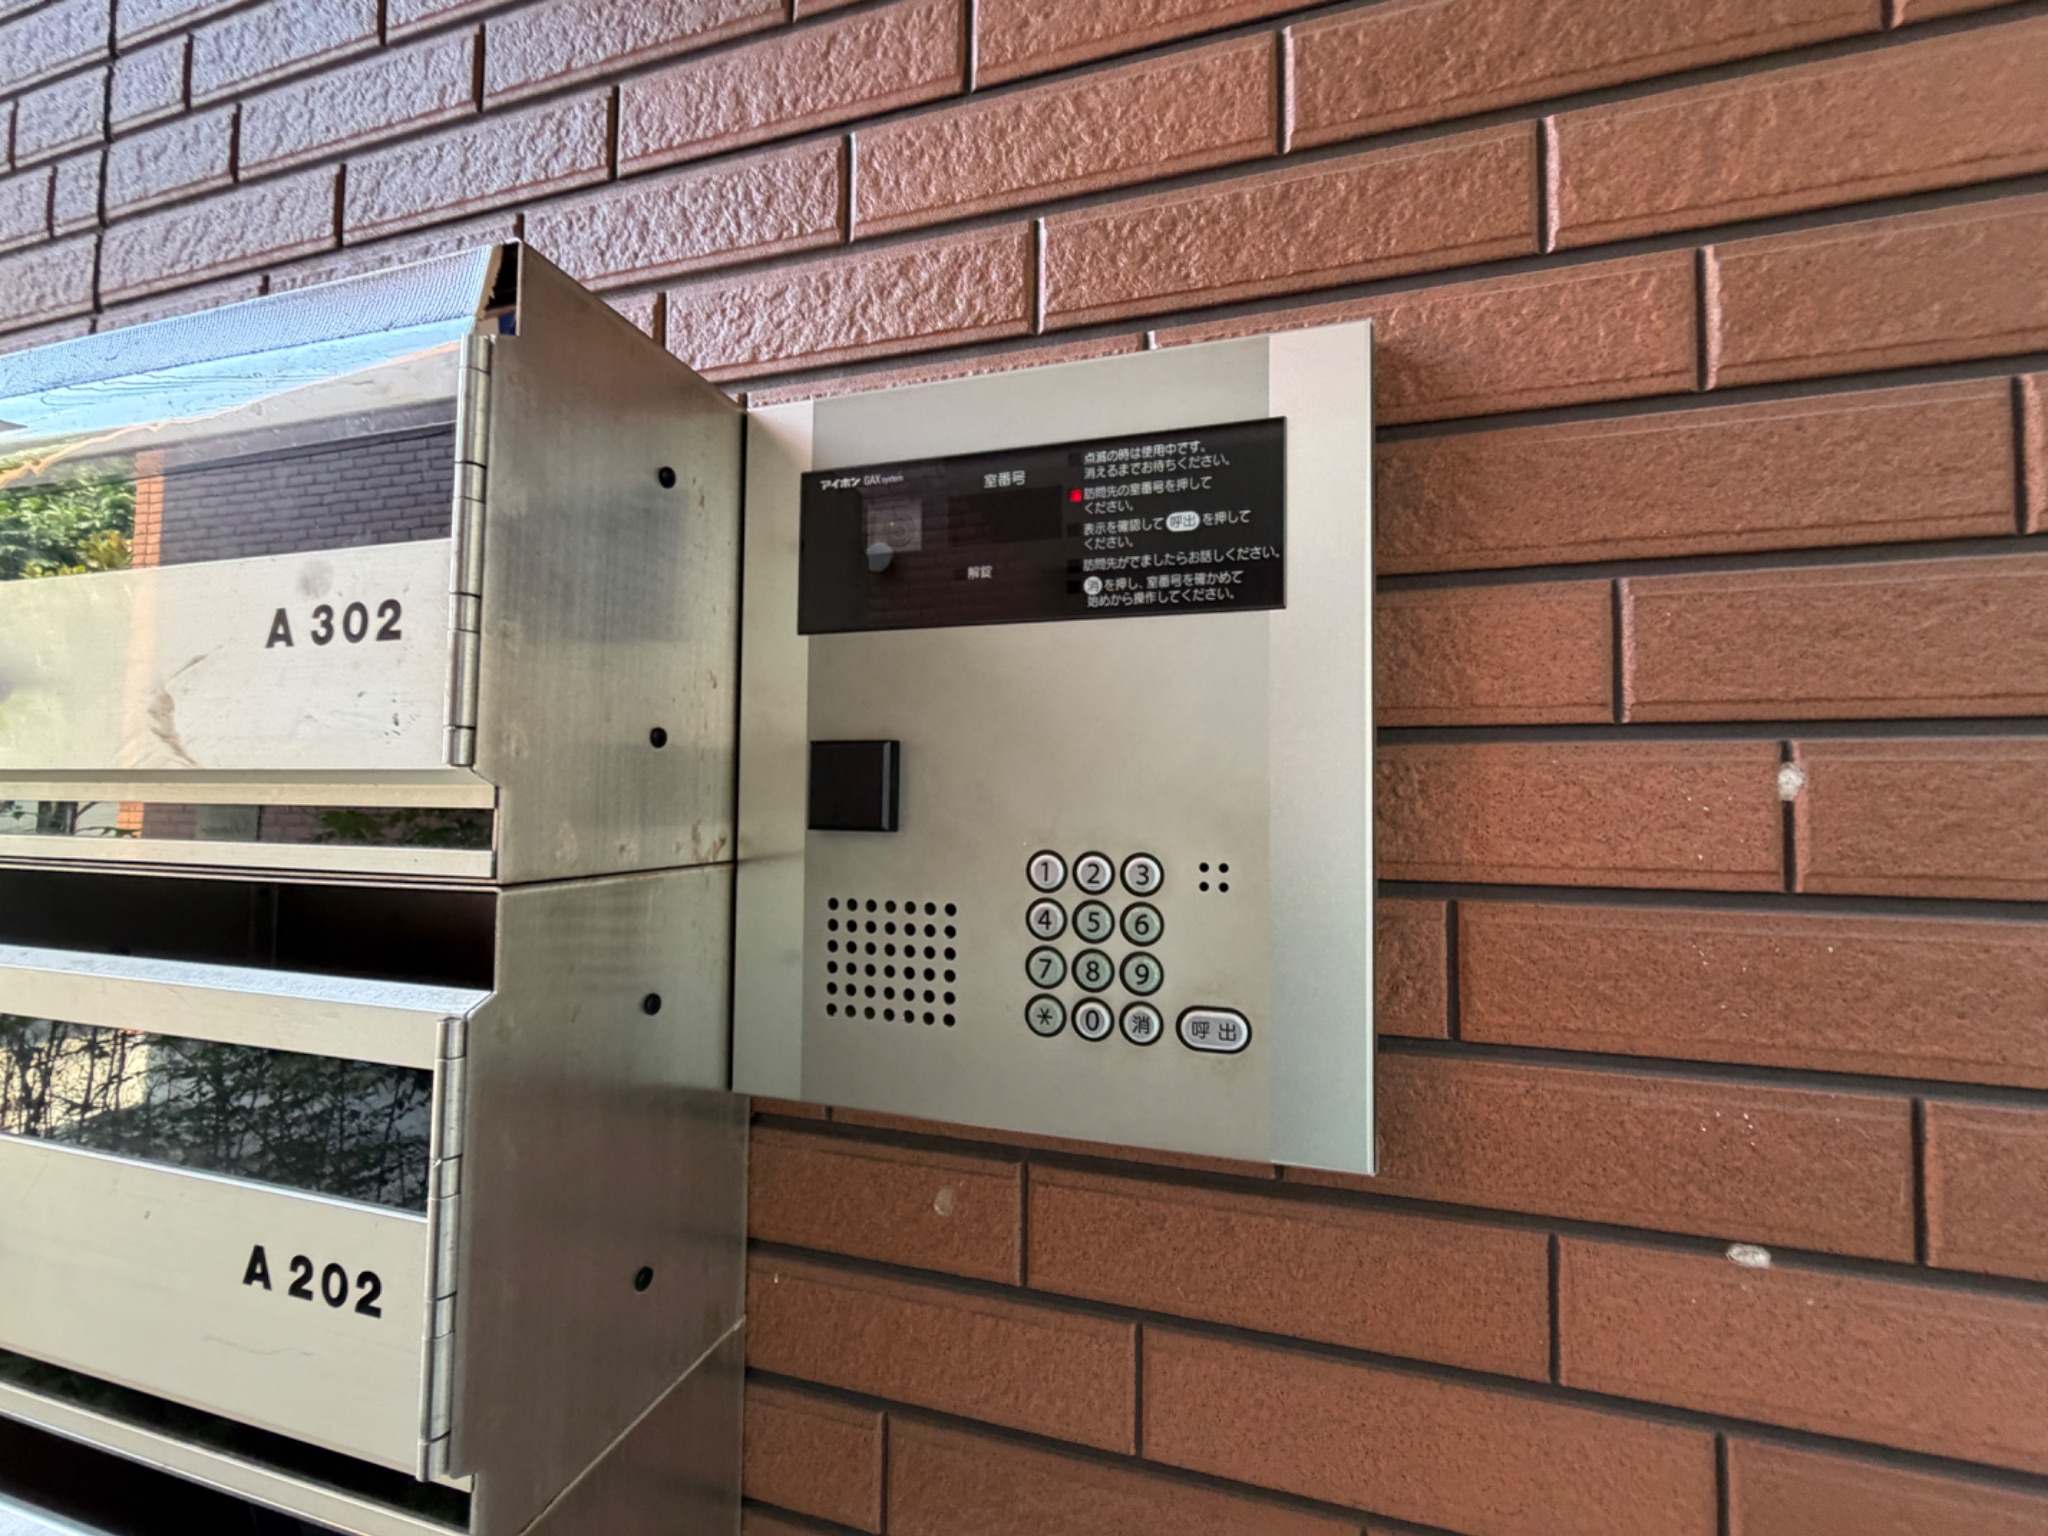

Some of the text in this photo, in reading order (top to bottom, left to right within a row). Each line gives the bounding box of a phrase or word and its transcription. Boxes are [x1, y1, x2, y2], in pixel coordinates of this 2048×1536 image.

[1084, 454, 1230, 479] 消えるまでお待ちください。
[863, 475, 881, 486] GAX
[983, 470, 1026, 489] 室番号
[1083, 476, 1212, 500] 訪問先の室番号を押して
[1084, 500, 1134, 514] ください。
[1169, 514, 1197, 528] 呼出
[1084, 536, 1134, 550] ください。
[1083, 546, 1280, 572] 訪問先がでましたらお話しください。
[967, 565, 993, 580] 解錠
[1087, 587, 1235, 608] 始めから操作してください。
[310, 599, 403, 646] 302
[1040, 862, 1149, 886] 1 2 3
[1038, 910, 1149, 935] 4 5 6
[1039, 958, 1149, 985] 7 8 9
[1085, 1010, 1100, 1031] 0
[1132, 1015, 1151, 1035] 消
[1191, 1020, 1237, 1042] 呼出
[289, 1253, 383, 1319] 202
